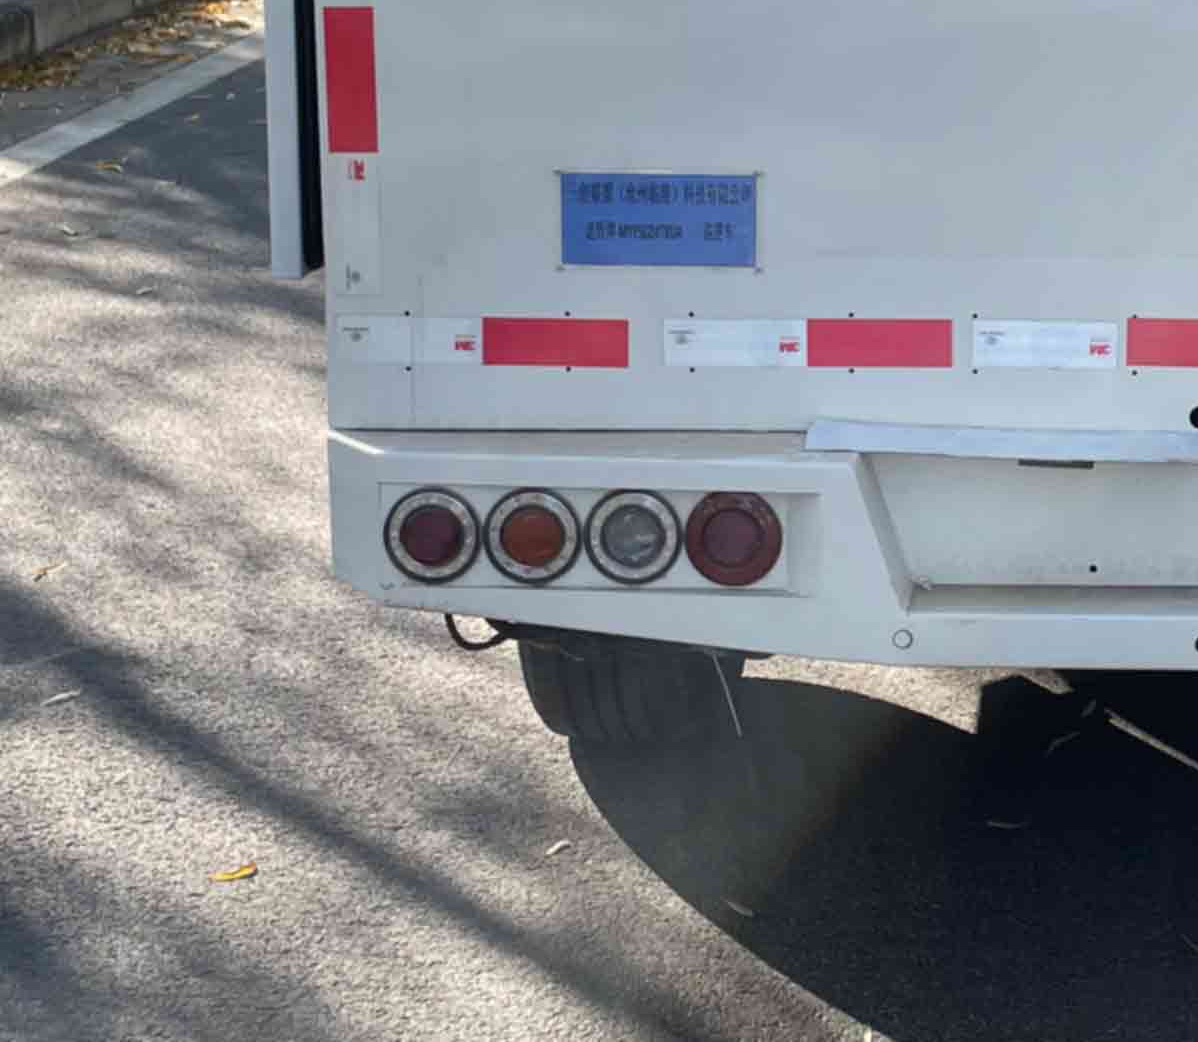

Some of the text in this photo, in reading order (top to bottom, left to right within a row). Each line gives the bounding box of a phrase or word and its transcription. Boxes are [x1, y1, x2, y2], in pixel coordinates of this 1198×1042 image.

[352, 160, 365, 182] 3M
[455, 341, 476, 351] 3M
[779, 341, 801, 353] 3M
[1089, 344, 1112, 355] 3M
